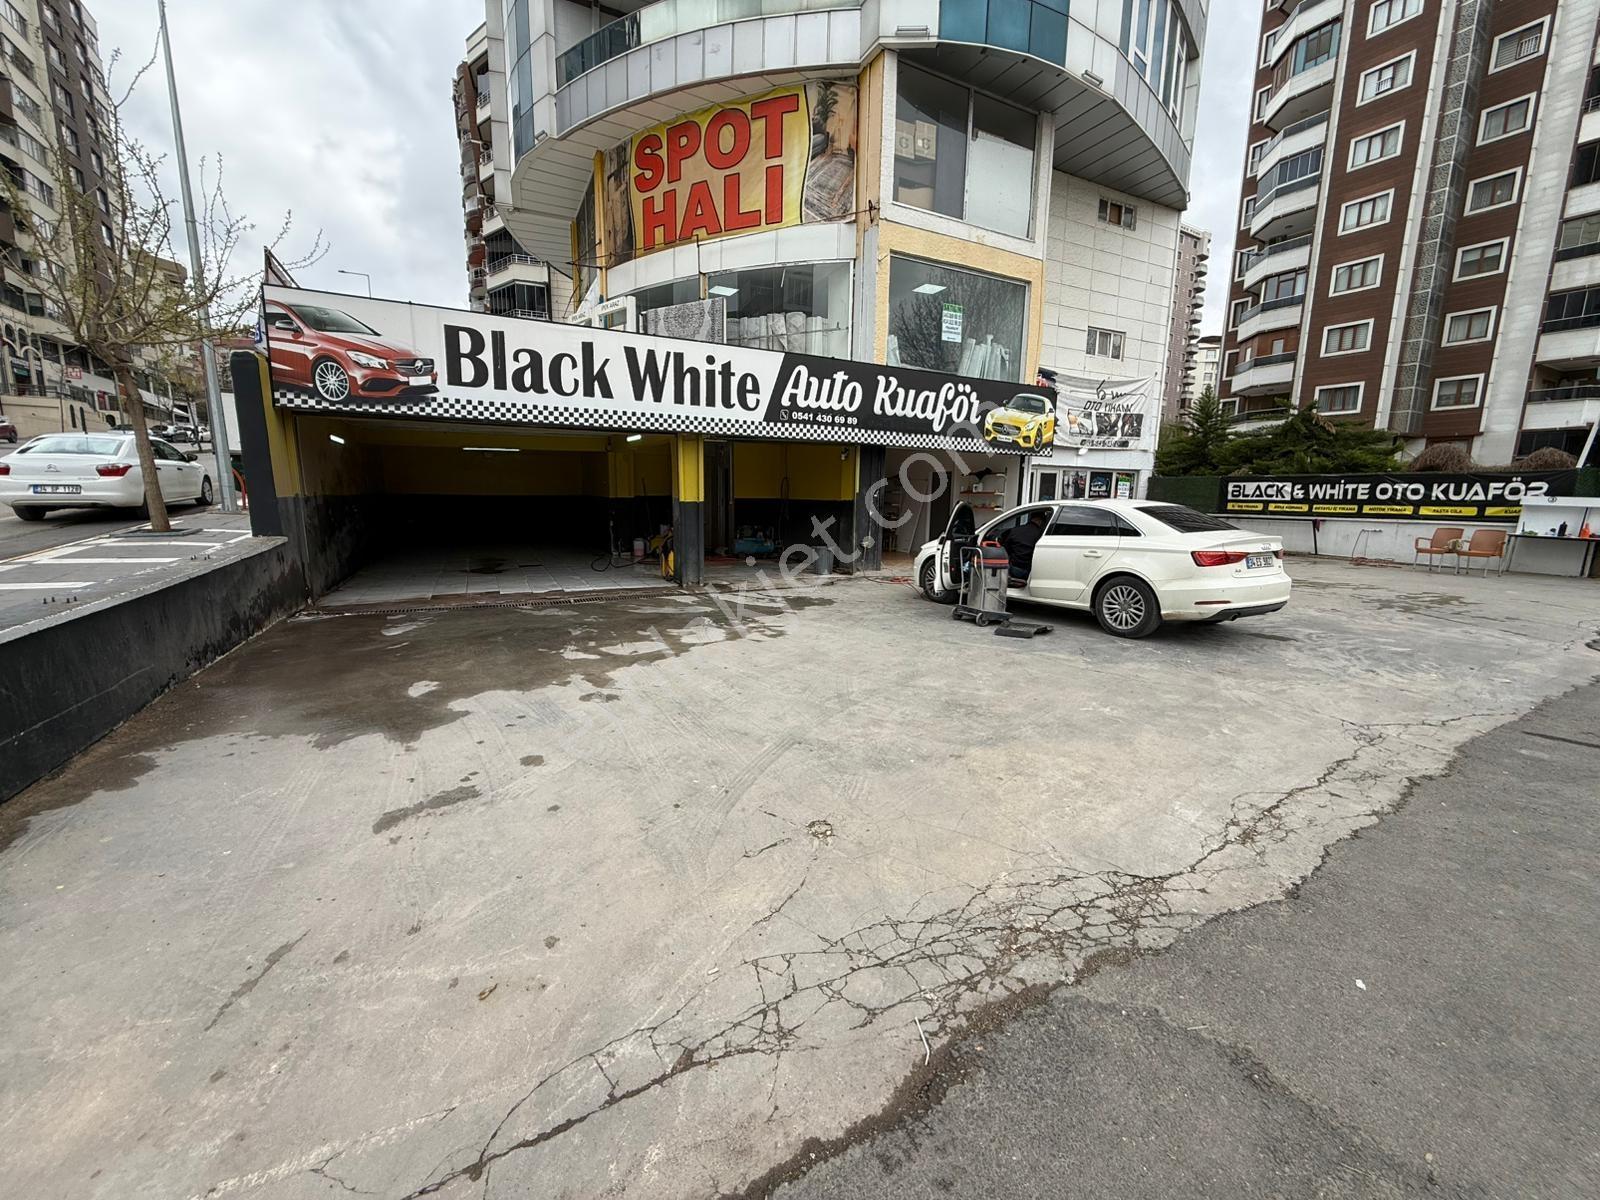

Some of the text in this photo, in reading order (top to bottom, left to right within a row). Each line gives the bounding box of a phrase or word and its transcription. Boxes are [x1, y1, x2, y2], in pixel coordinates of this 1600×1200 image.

[634, 93, 799, 193] SPOT
[642, 164, 784, 250] HALI
[443, 324, 982, 432] Black White Auto Kuaför
[1084, 400, 1102, 411] OTO
[792, 412, 813, 421] 0541
[816, 414, 832, 423] 430
[1231, 484, 1288, 498] BLACK
[1293, 484, 1304, 499] &
[1376, 483, 1425, 501] OTO
[1431, 477, 1549, 501] KUAFÖR
